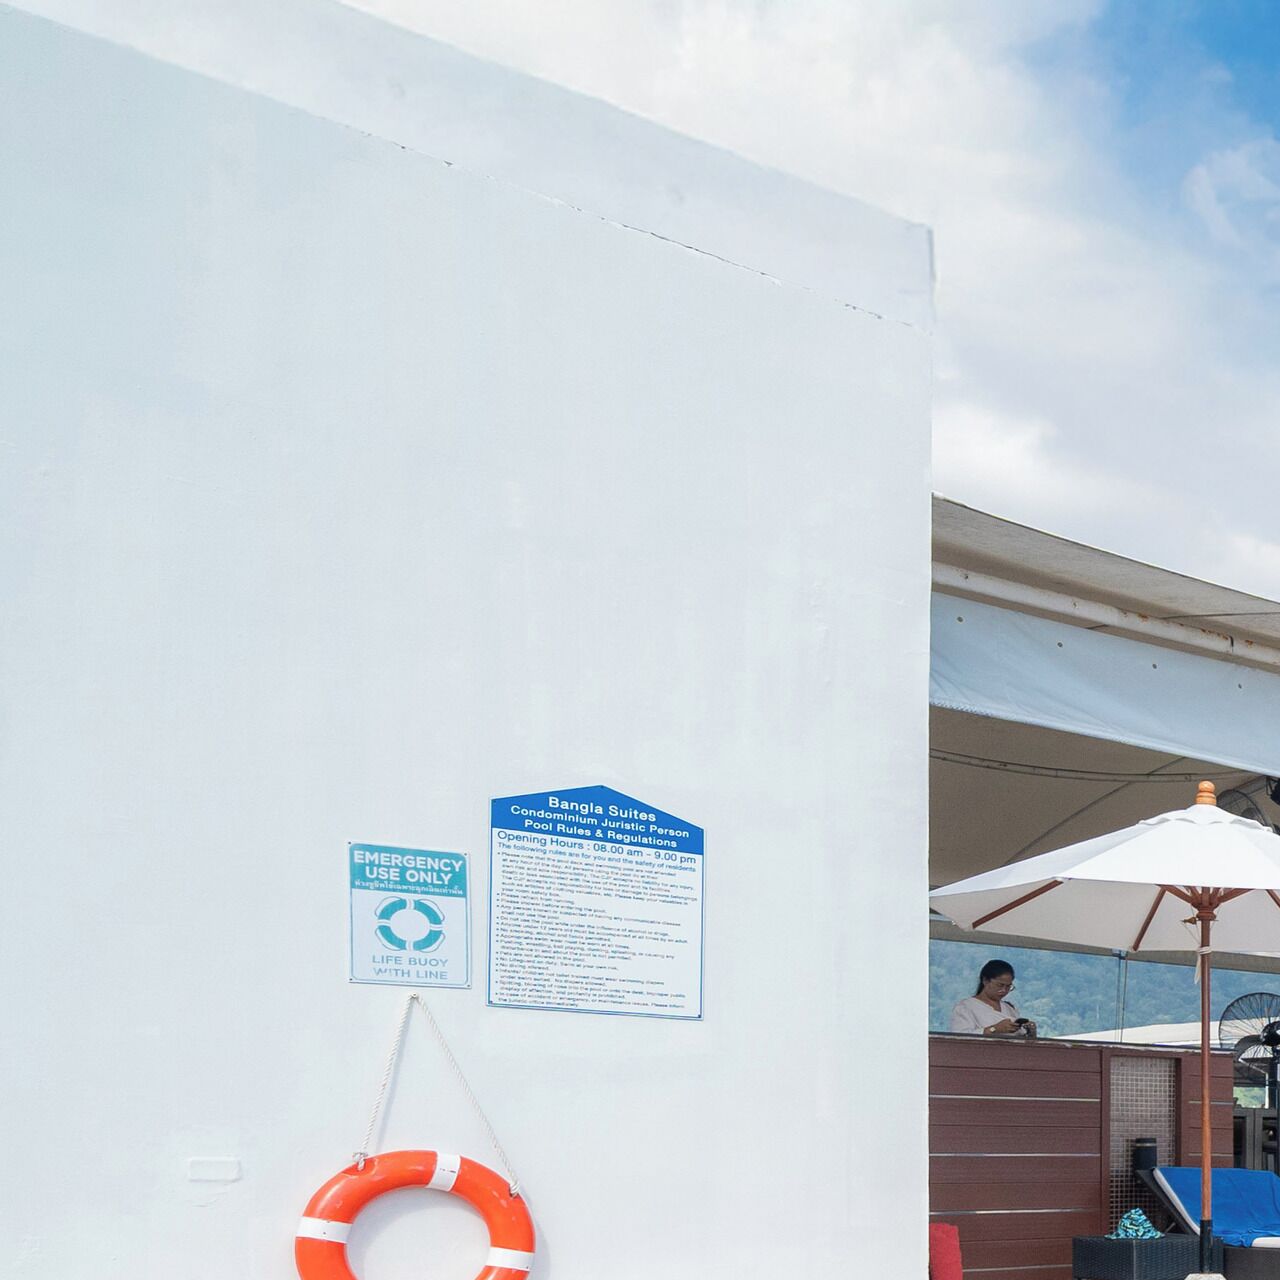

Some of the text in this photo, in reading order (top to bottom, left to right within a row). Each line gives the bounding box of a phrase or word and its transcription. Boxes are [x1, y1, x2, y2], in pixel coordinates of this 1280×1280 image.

[548, 796, 657, 822] Bangla Suites
[510, 805, 690, 838] Condominium Juristic Person
[524, 819, 677, 848] Pool Rules & Regulations
[497, 830, 547, 847] Opening
[550, 837, 584, 850] Hours
[593, 842, 624, 855] 08.00
[626, 848, 643, 857] am
[654, 851, 677, 862] 9.00
[680, 855, 697, 865] pm
[353, 850, 463, 872] EMERGENCY
[635, 860, 655, 869] safety
[365, 866, 453, 885] USE ONLY
[372, 955, 449, 967] LIFE BUOY
[416, 970, 448, 980] LINE
